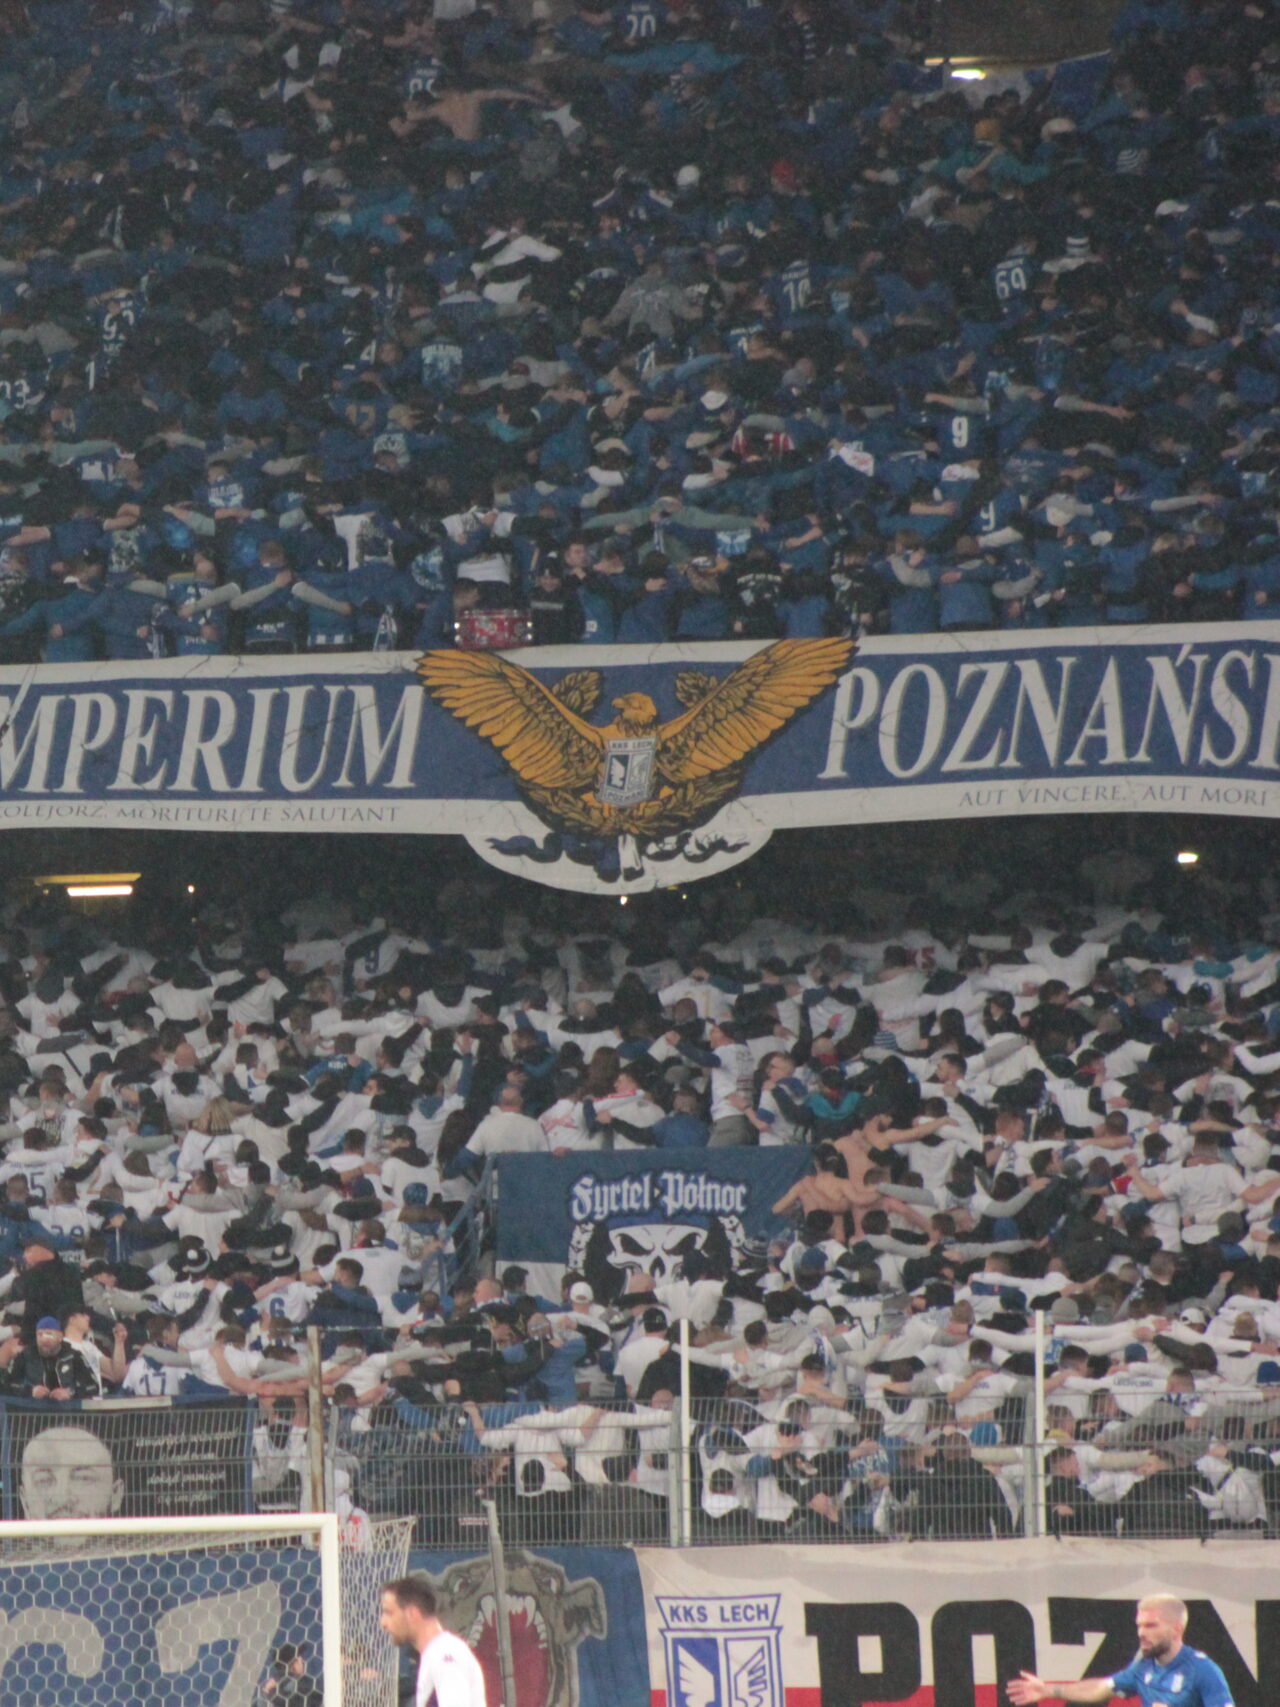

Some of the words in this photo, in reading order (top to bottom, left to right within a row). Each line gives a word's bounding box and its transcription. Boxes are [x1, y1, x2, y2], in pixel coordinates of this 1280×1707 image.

[952, 416, 969, 448] 9
[959, 789, 1008, 808] AUT
[1141, 784, 1192, 802] AUT
[1199, 786, 1267, 807] MORI
[117, 806, 237, 823] MORITURI
[248, 807, 273, 822] TE
[280, 806, 402, 823] SALUTANT
[669, 1604, 709, 1623] KKS
[719, 1603, 770, 1623] LECH
